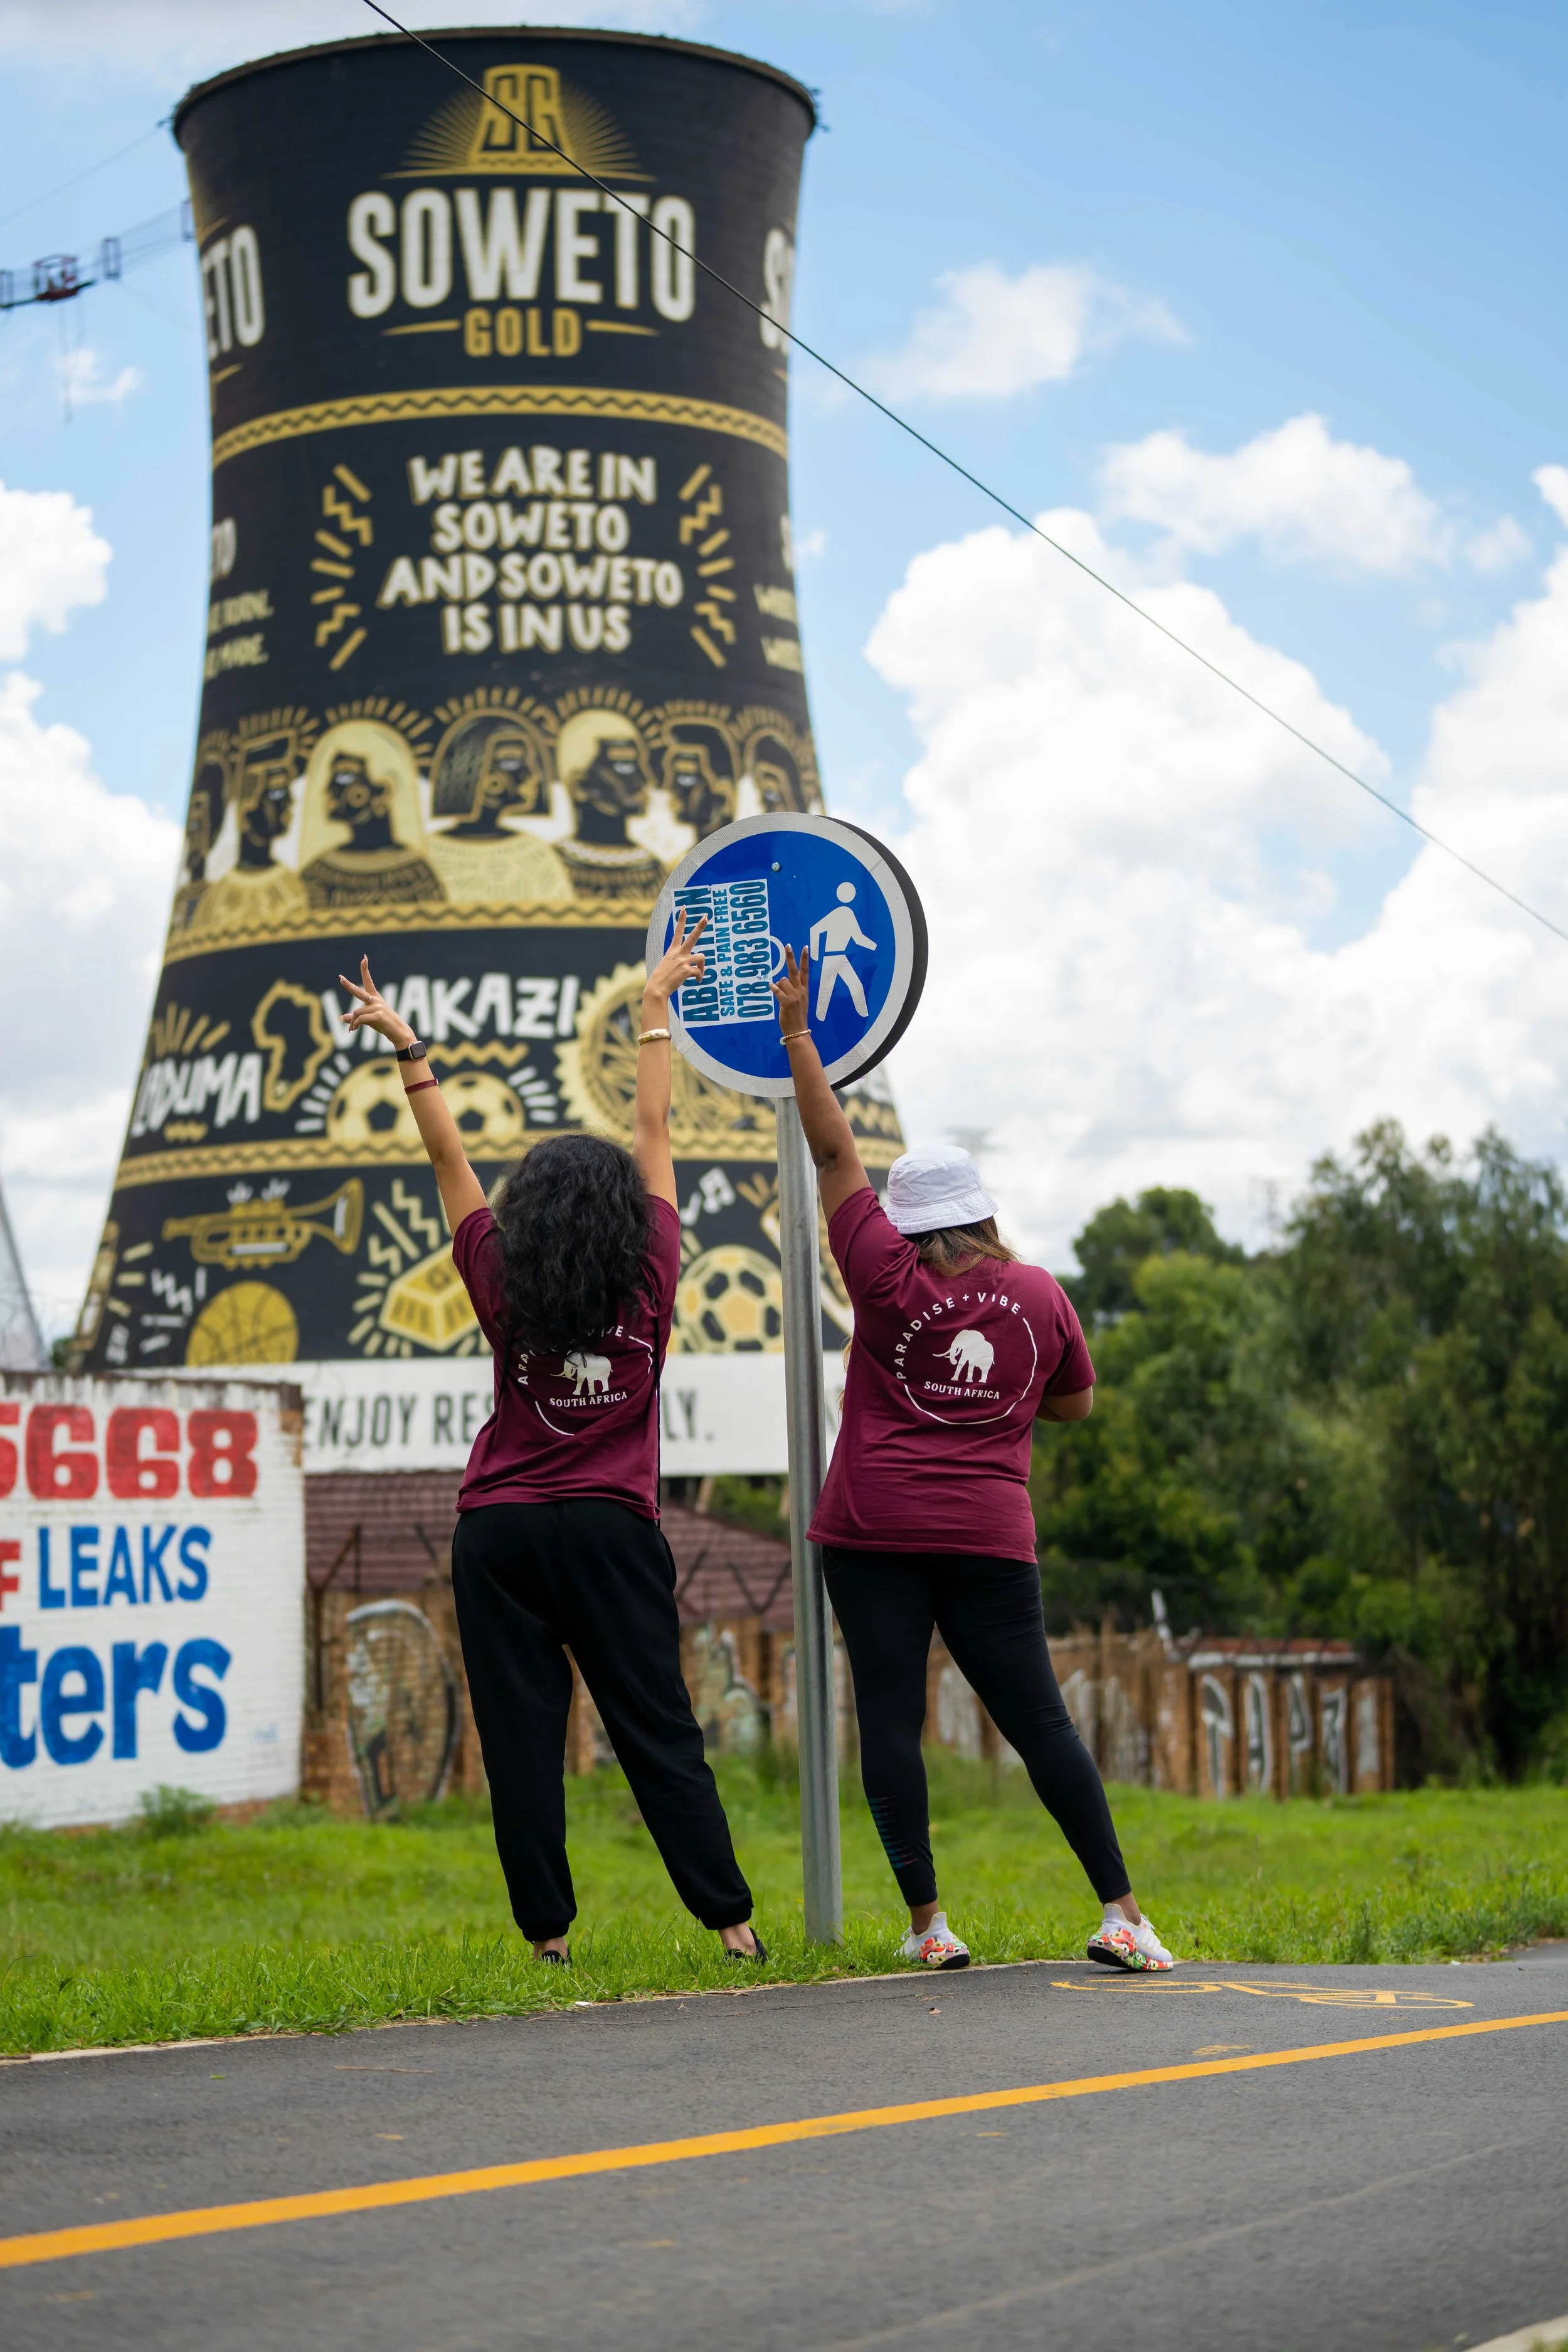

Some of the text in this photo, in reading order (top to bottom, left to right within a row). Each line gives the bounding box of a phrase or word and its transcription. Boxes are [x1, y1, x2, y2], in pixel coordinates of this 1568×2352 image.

[348, 187, 696, 322] SOWETO
[464, 307, 582, 357] GOLD
[408, 445, 657, 506] WE ARE IN
[432, 501, 630, 553] SOWETO
[378, 552, 685, 608] AND SOWETO
[442, 602, 632, 655] IS IN US
[712, 889, 735, 1017] SAFE & PAIN FREE
[729, 881, 774, 1019] 078 983 6560
[894, 1297, 955, 1380] PARADISE
[977, 1292, 1021, 1315] VIBE
[549, 1391, 628, 1407] SOUTH AFRICA
[923, 1381, 1000, 1400] SOUTH AFRICA
[38, 1524, 213, 1610] LEAKS
